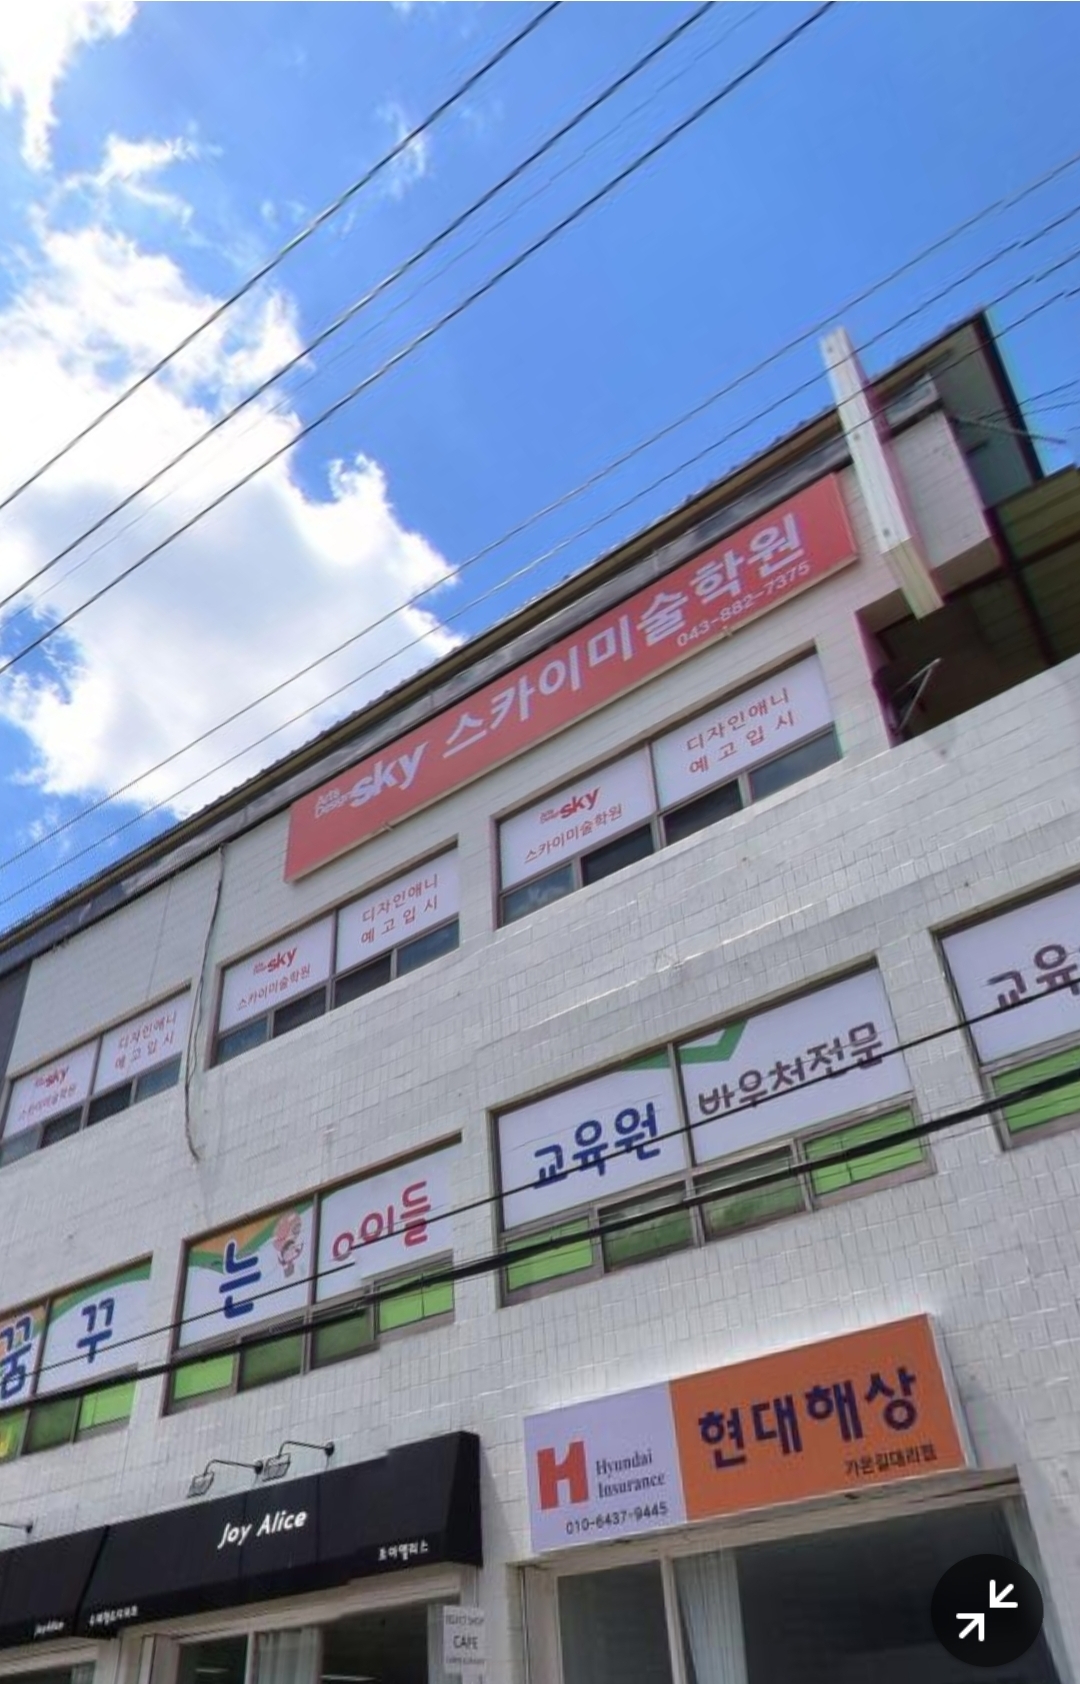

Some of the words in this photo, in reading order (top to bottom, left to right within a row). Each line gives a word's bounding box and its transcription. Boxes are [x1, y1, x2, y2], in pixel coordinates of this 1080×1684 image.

[676, 560, 810, 647] 043-882-7375
[443, 513, 804, 758] 스카이미술학원
[686, 687, 789, 751] 디자인애니
[349, 741, 429, 807] sky
[560, 786, 600, 819] sky
[524, 803, 623, 863] 스카이미술학원
[362, 873, 438, 922] 디자인애니
[267, 947, 298, 973] sky
[986, 944, 1080, 1007] 교육
[533, 1102, 661, 1189] 교육원
[698, 1366, 917, 1469] 현대해상
[596, 1448, 653, 1479] Hyundai
[598, 1474, 667, 1498] Insurance
[217, 1522, 253, 1550] Joy
[256, 1510, 307, 1537] Alice
[566, 1501, 669, 1535] 010-6437-9445
[453, 1635, 478, 1650] CAFE
